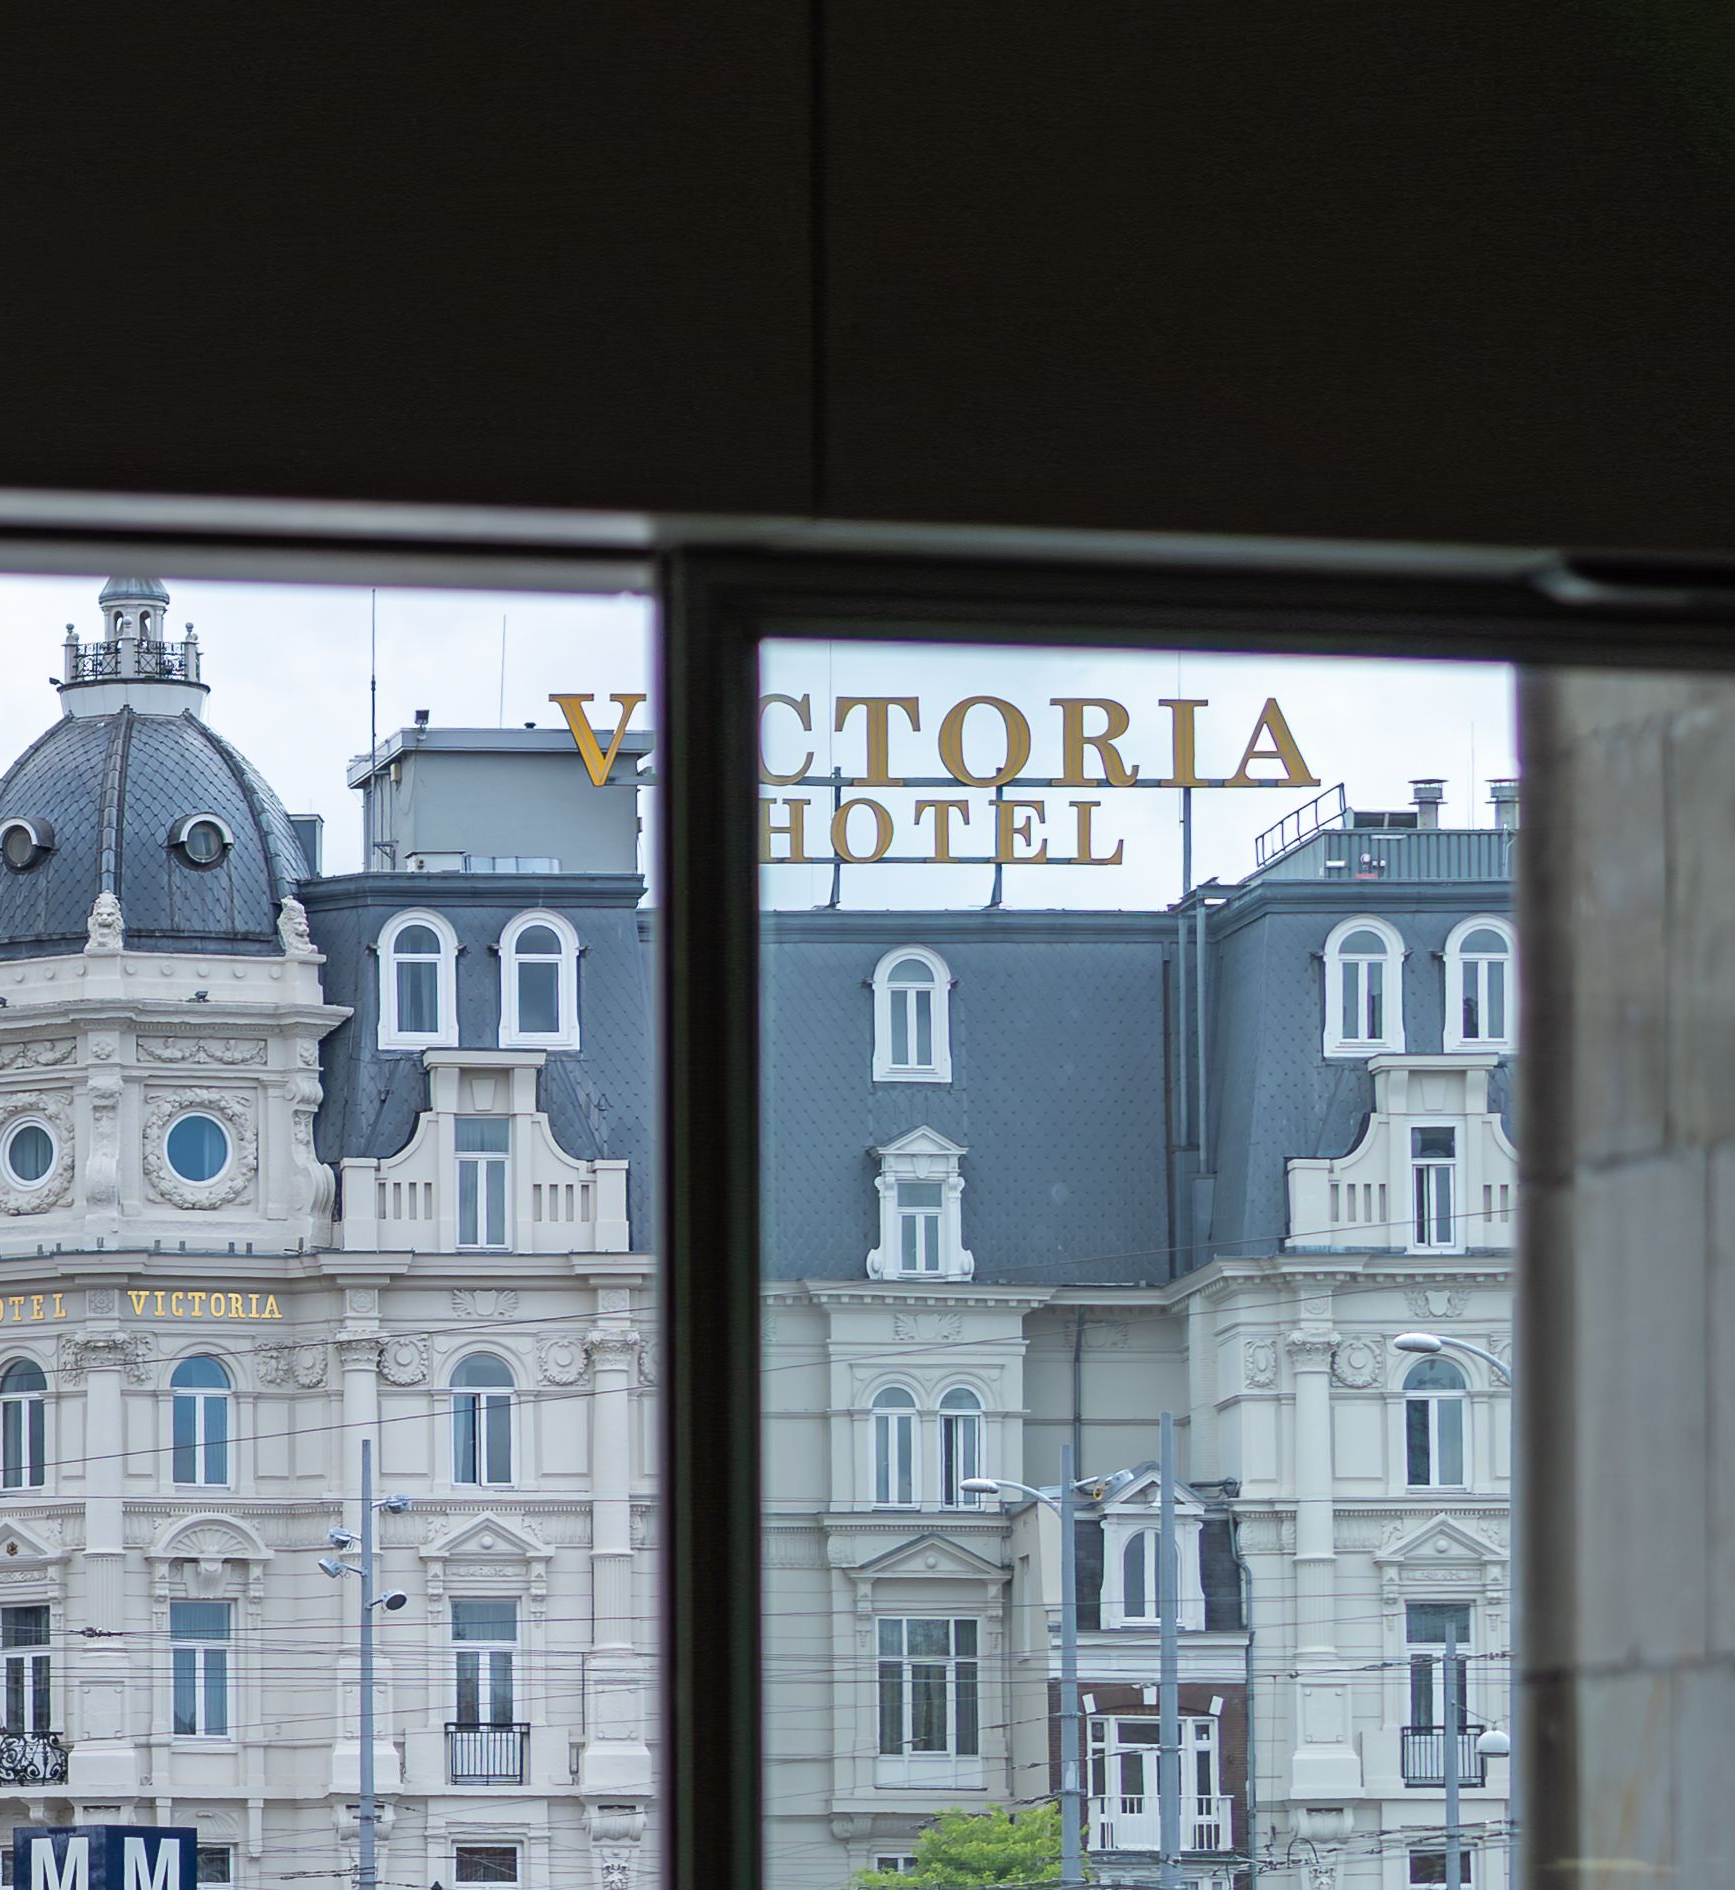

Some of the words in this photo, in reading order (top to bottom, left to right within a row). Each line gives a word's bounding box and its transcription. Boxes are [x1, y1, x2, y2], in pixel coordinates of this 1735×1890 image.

[547, 692, 1321, 788] VCTORIA
[761, 797, 1125, 867] HOTEL
[127, 1290, 283, 1319] VICTORIA
